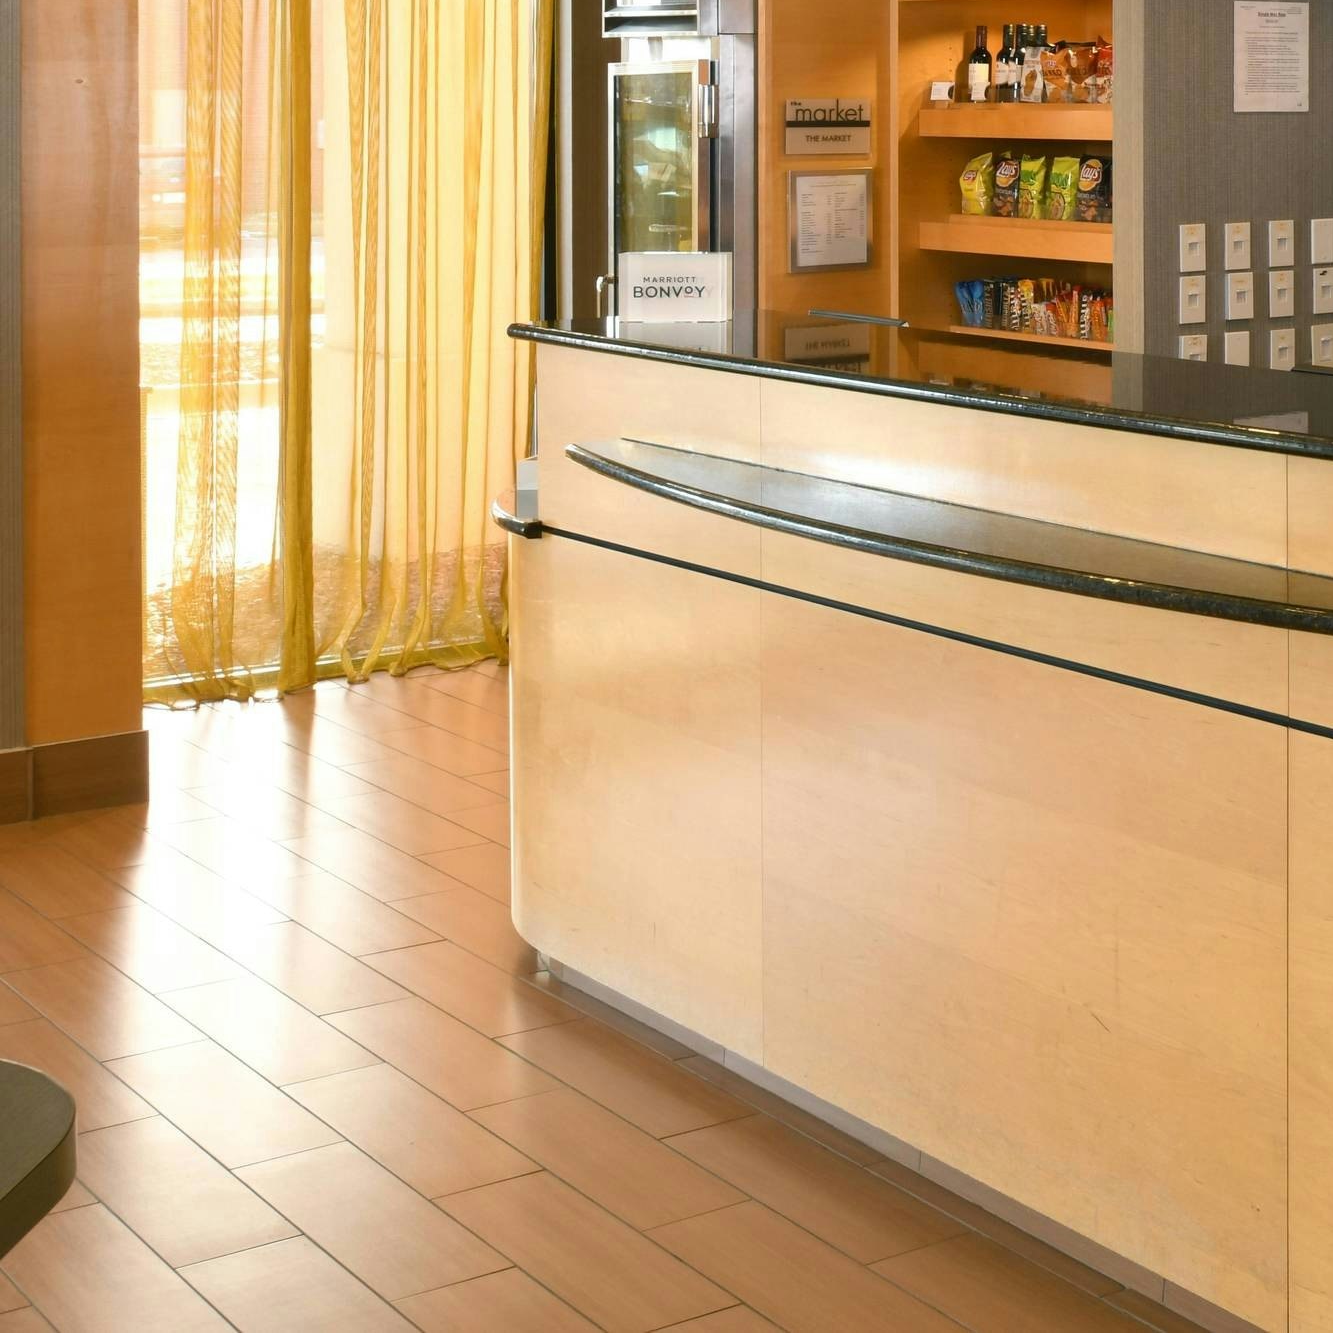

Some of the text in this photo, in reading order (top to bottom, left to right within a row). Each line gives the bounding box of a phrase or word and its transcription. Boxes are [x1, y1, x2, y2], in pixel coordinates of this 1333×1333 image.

[795, 98, 864, 122] market
[806, 134, 852, 143] THE MARKET
[633, 285, 706, 298] BONVOY
